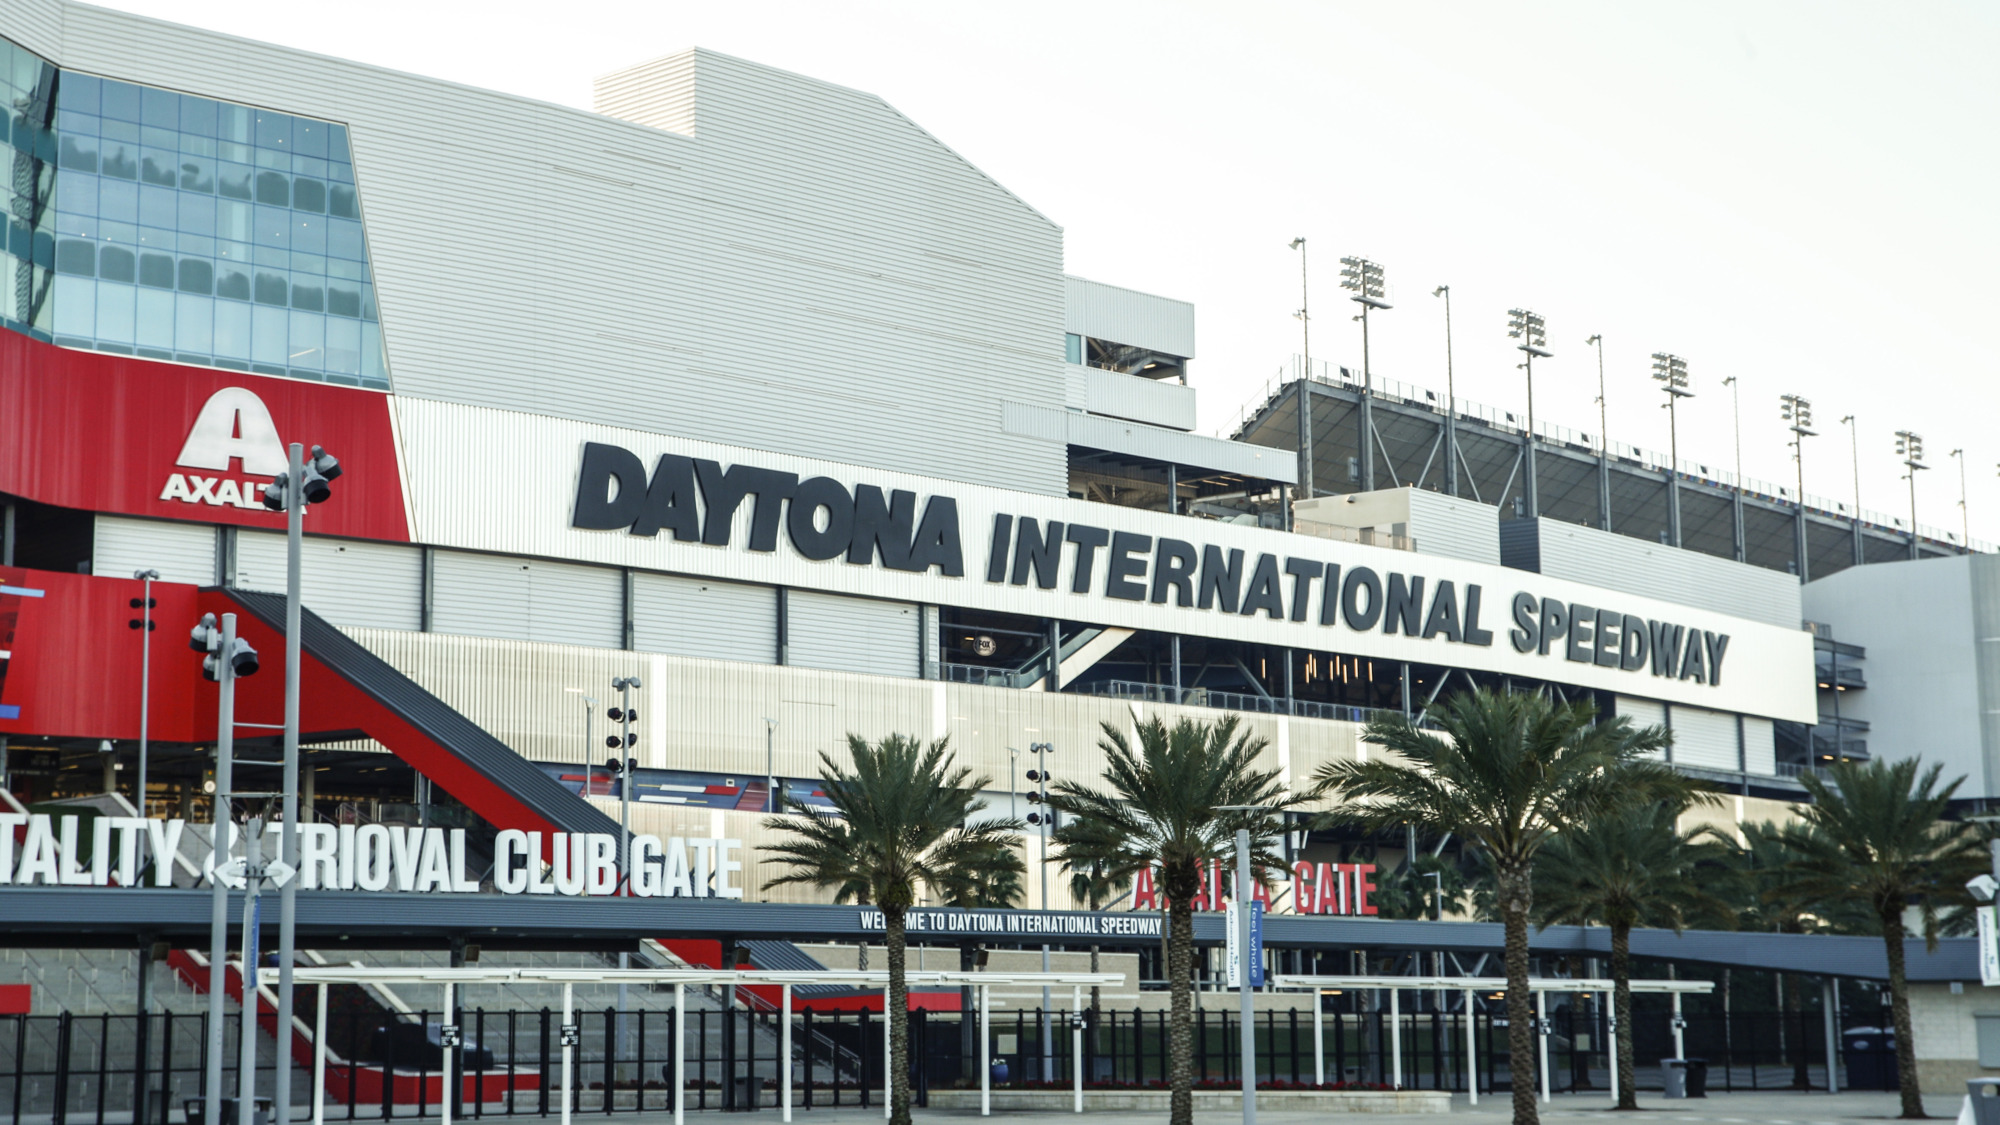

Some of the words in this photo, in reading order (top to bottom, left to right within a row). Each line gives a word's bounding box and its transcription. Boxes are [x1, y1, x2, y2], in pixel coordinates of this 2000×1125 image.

[159, 473, 308, 515] AXAL
[572, 441, 965, 577] DAYTONA
[987, 512, 1493, 646] INTERNATIONAL
[1511, 591, 1730, 687] SPEEDWAY
[495, 829, 617, 895] CLUB
[630, 834, 742, 897] GATE
[1130, 857, 1272, 912] AALA
[1291, 861, 1378, 915] GATE
[860, 911, 925, 930] WELME
[929, 913, 945, 930] TO
[949, 914, 1003, 932] DAYTONA
[1006, 915, 1098, 933] INTERNATIONAL
[1101, 918, 1162, 935] SPEEDWAY
[1250, 936, 1258, 978] whole
